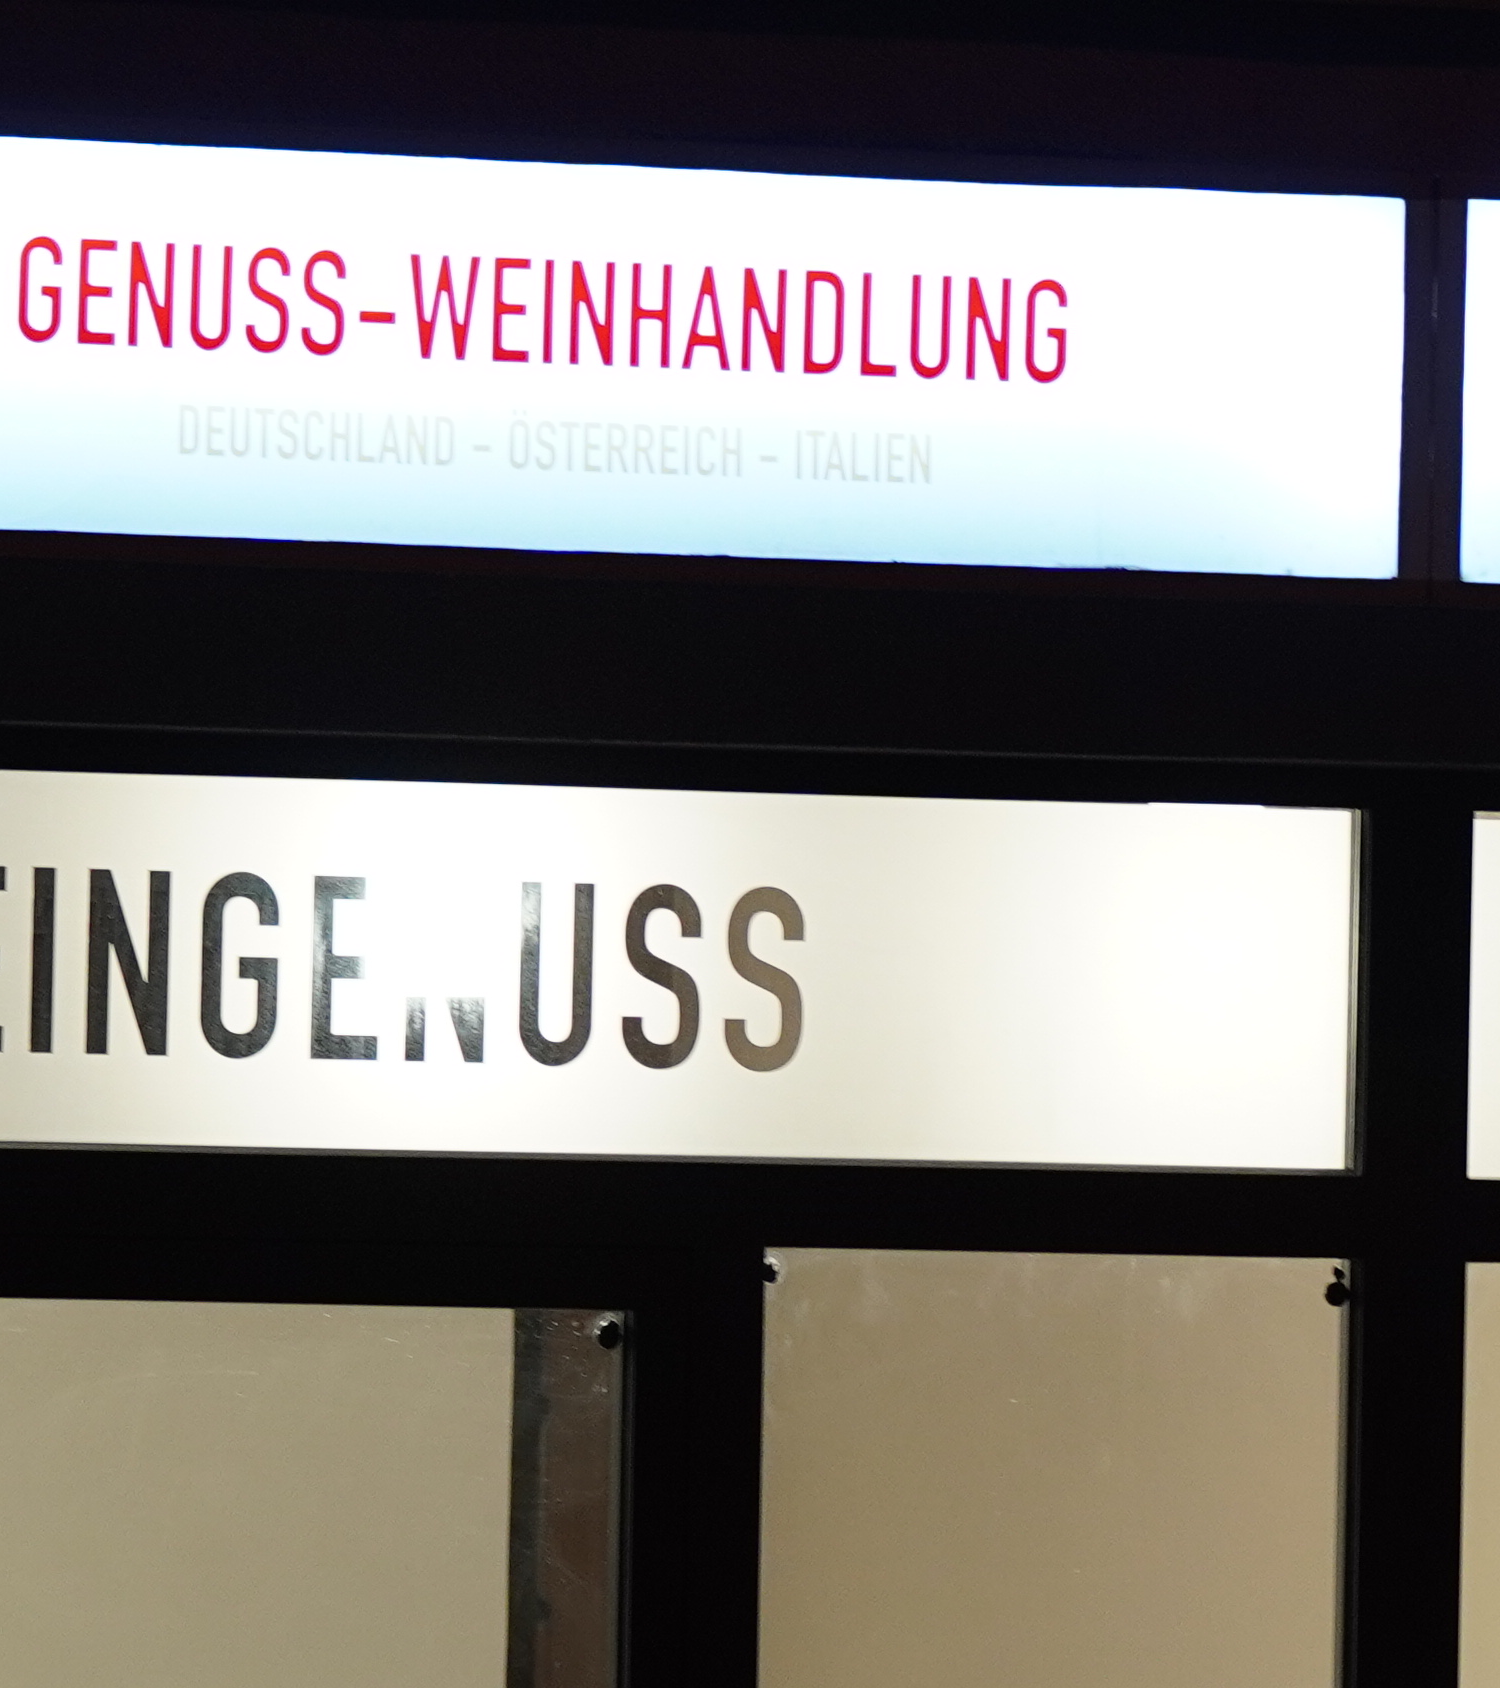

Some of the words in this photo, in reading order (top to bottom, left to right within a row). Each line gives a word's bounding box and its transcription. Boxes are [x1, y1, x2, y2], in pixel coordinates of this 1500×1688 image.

[16, 235, 1068, 384] GENUSS-WEINHANDLUNG
[177, 403, 457, 468] DEUTSCHLAND
[507, 410, 744, 479] ÖSTERREICH
[795, 428, 933, 485] ITALIEN
